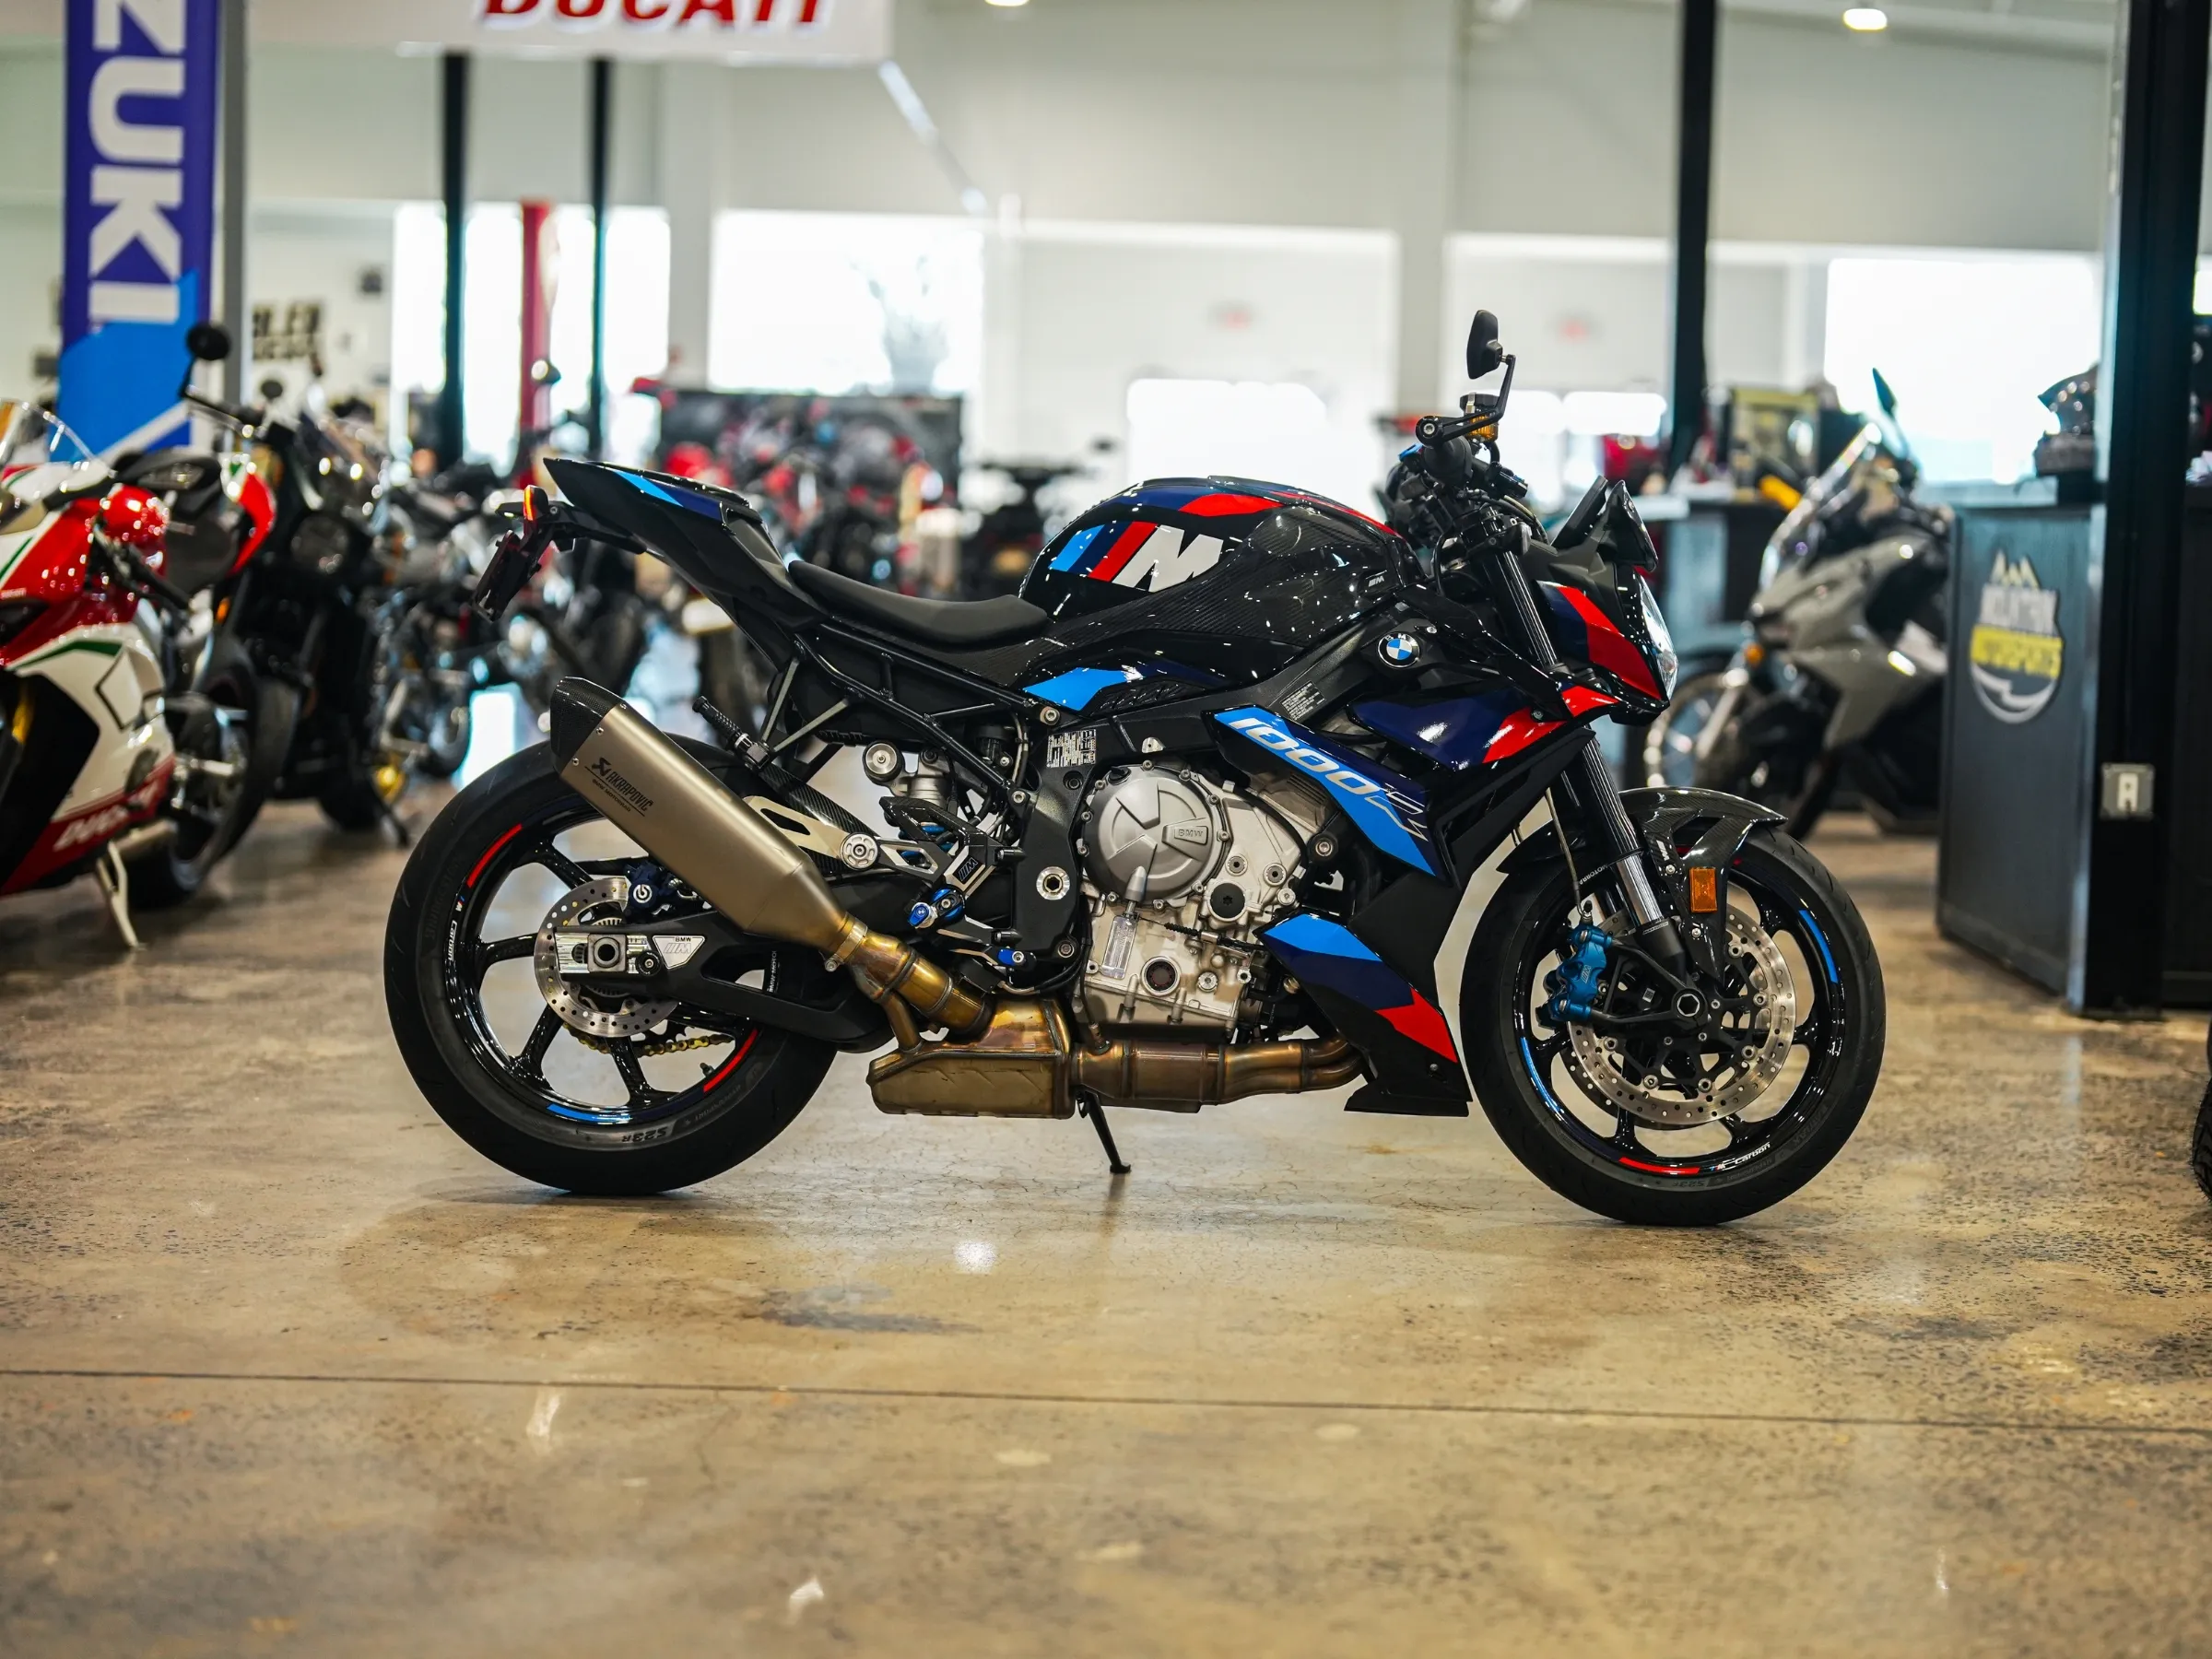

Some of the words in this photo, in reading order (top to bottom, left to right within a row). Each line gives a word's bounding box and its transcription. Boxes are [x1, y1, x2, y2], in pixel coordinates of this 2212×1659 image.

[1178, 829, 1204, 838] BMW
[447, 920, 458, 962] Carbon
[621, 1125, 668, 1144] S23R
